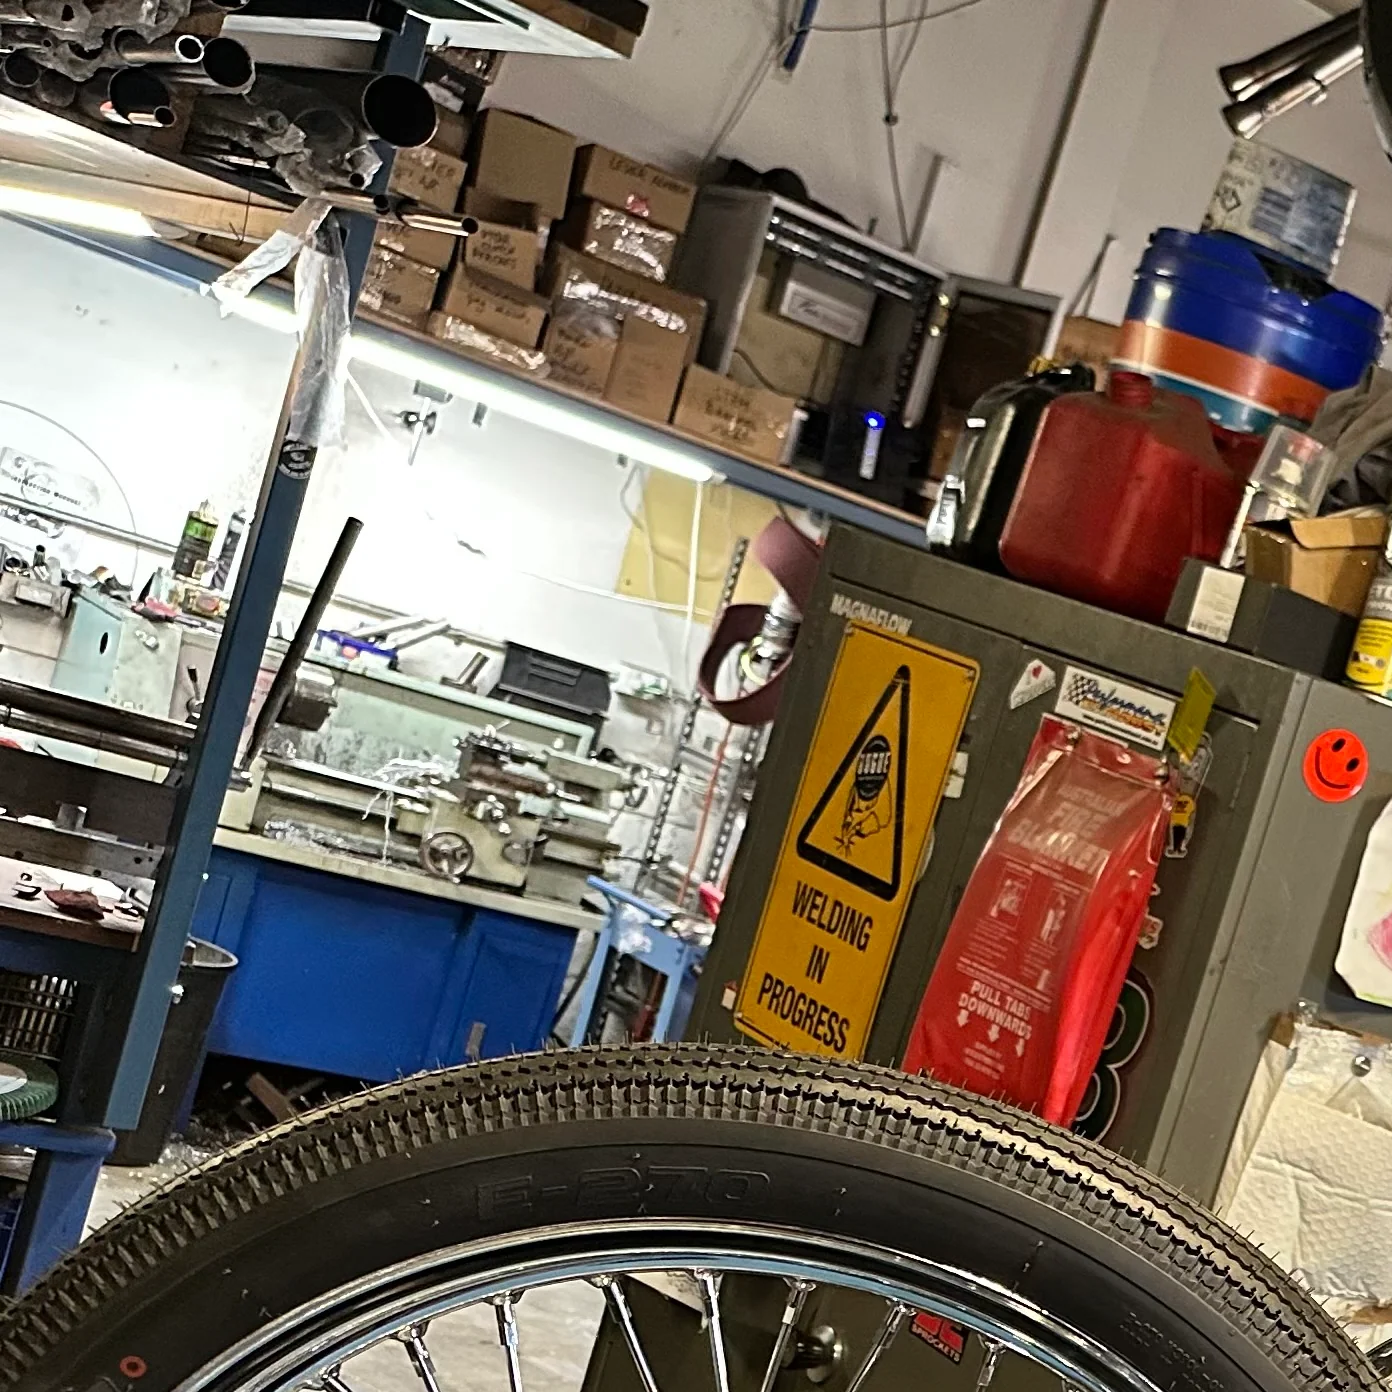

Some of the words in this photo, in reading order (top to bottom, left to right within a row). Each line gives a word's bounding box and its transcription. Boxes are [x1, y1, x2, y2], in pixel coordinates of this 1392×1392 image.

[829, 593, 913, 637] MAGNAFLOW
[1046, 800, 1109, 841] FIRE
[792, 880, 874, 953] WELDING
[805, 944, 831, 985] IN
[757, 972, 850, 1054] PROGRESS
[958, 993, 1033, 1041] DOWNWARDS
[970, 980, 1001, 1005] PULL
[1005, 997, 1032, 1021] TABS
[477, 1166, 772, 1222] E-270
